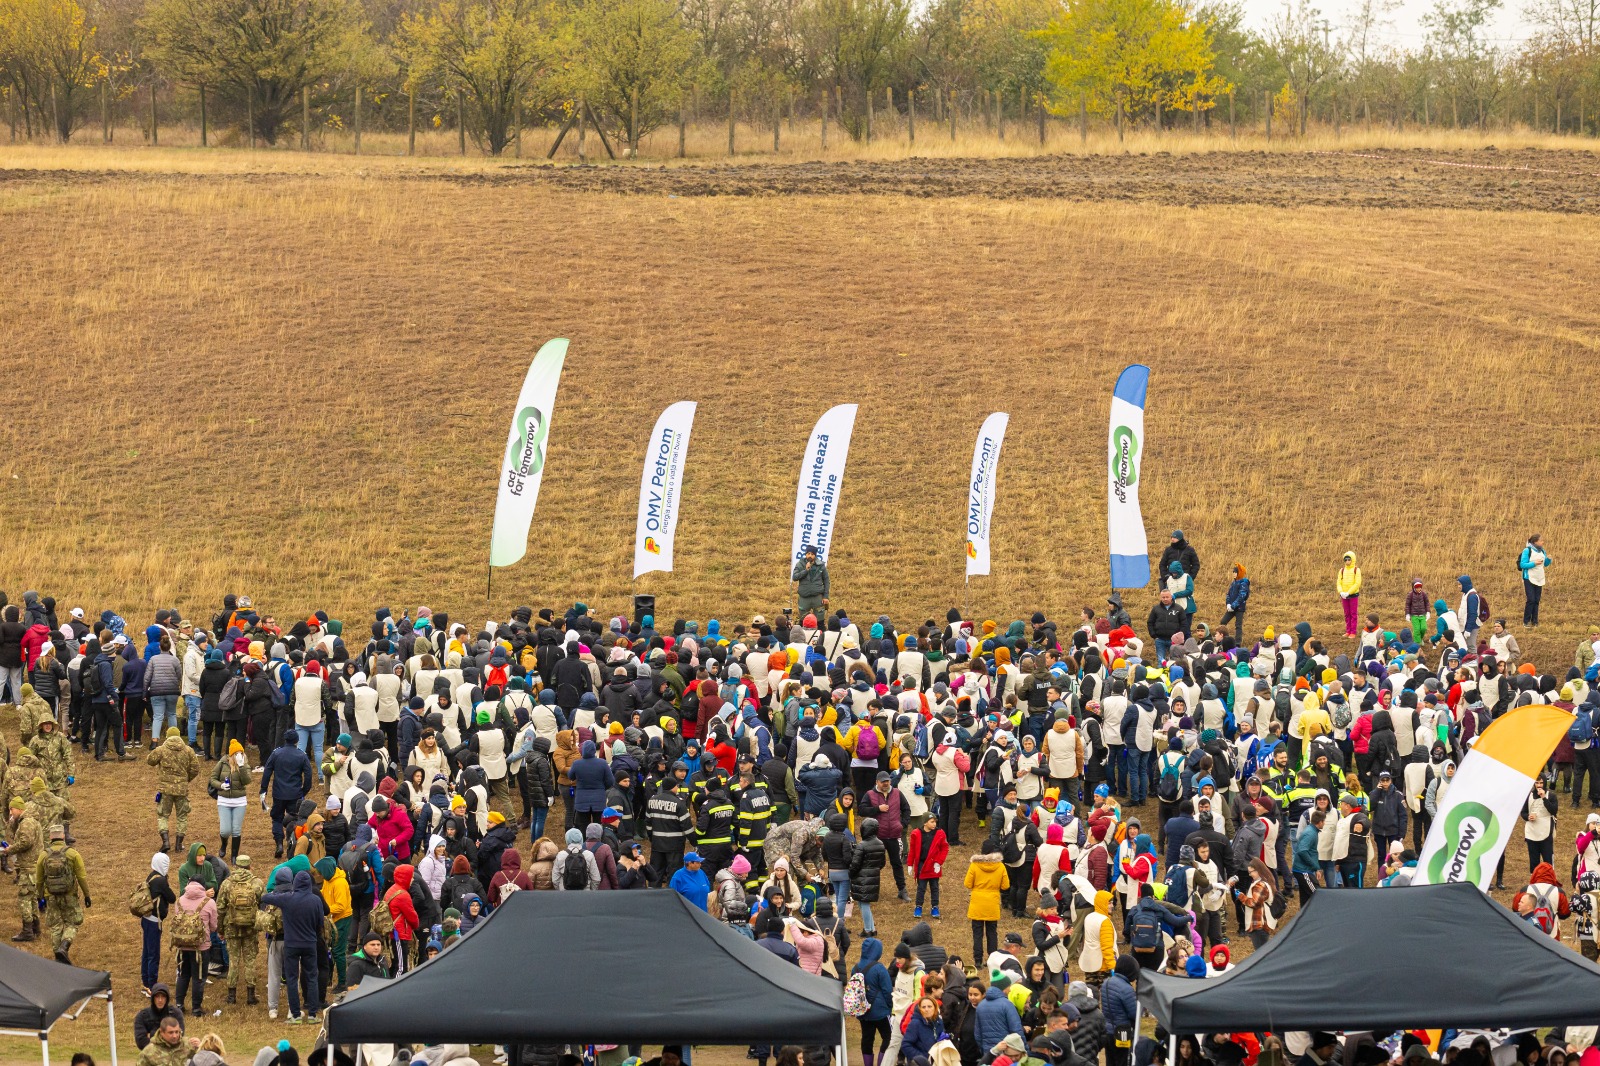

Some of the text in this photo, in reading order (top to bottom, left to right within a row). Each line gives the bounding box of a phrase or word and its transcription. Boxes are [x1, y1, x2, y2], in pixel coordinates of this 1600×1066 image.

[507, 469, 516, 488] act
[510, 421, 536, 496] for tomorrow
[646, 428, 673, 531] OMV Petrom
[807, 434, 830, 501] plantează
[968, 436, 993, 535] OMV Petrom
[1119, 438, 1129, 504] for tomorrow
[821, 473, 838, 516] mâine
[1447, 822, 1477, 884] morrow
